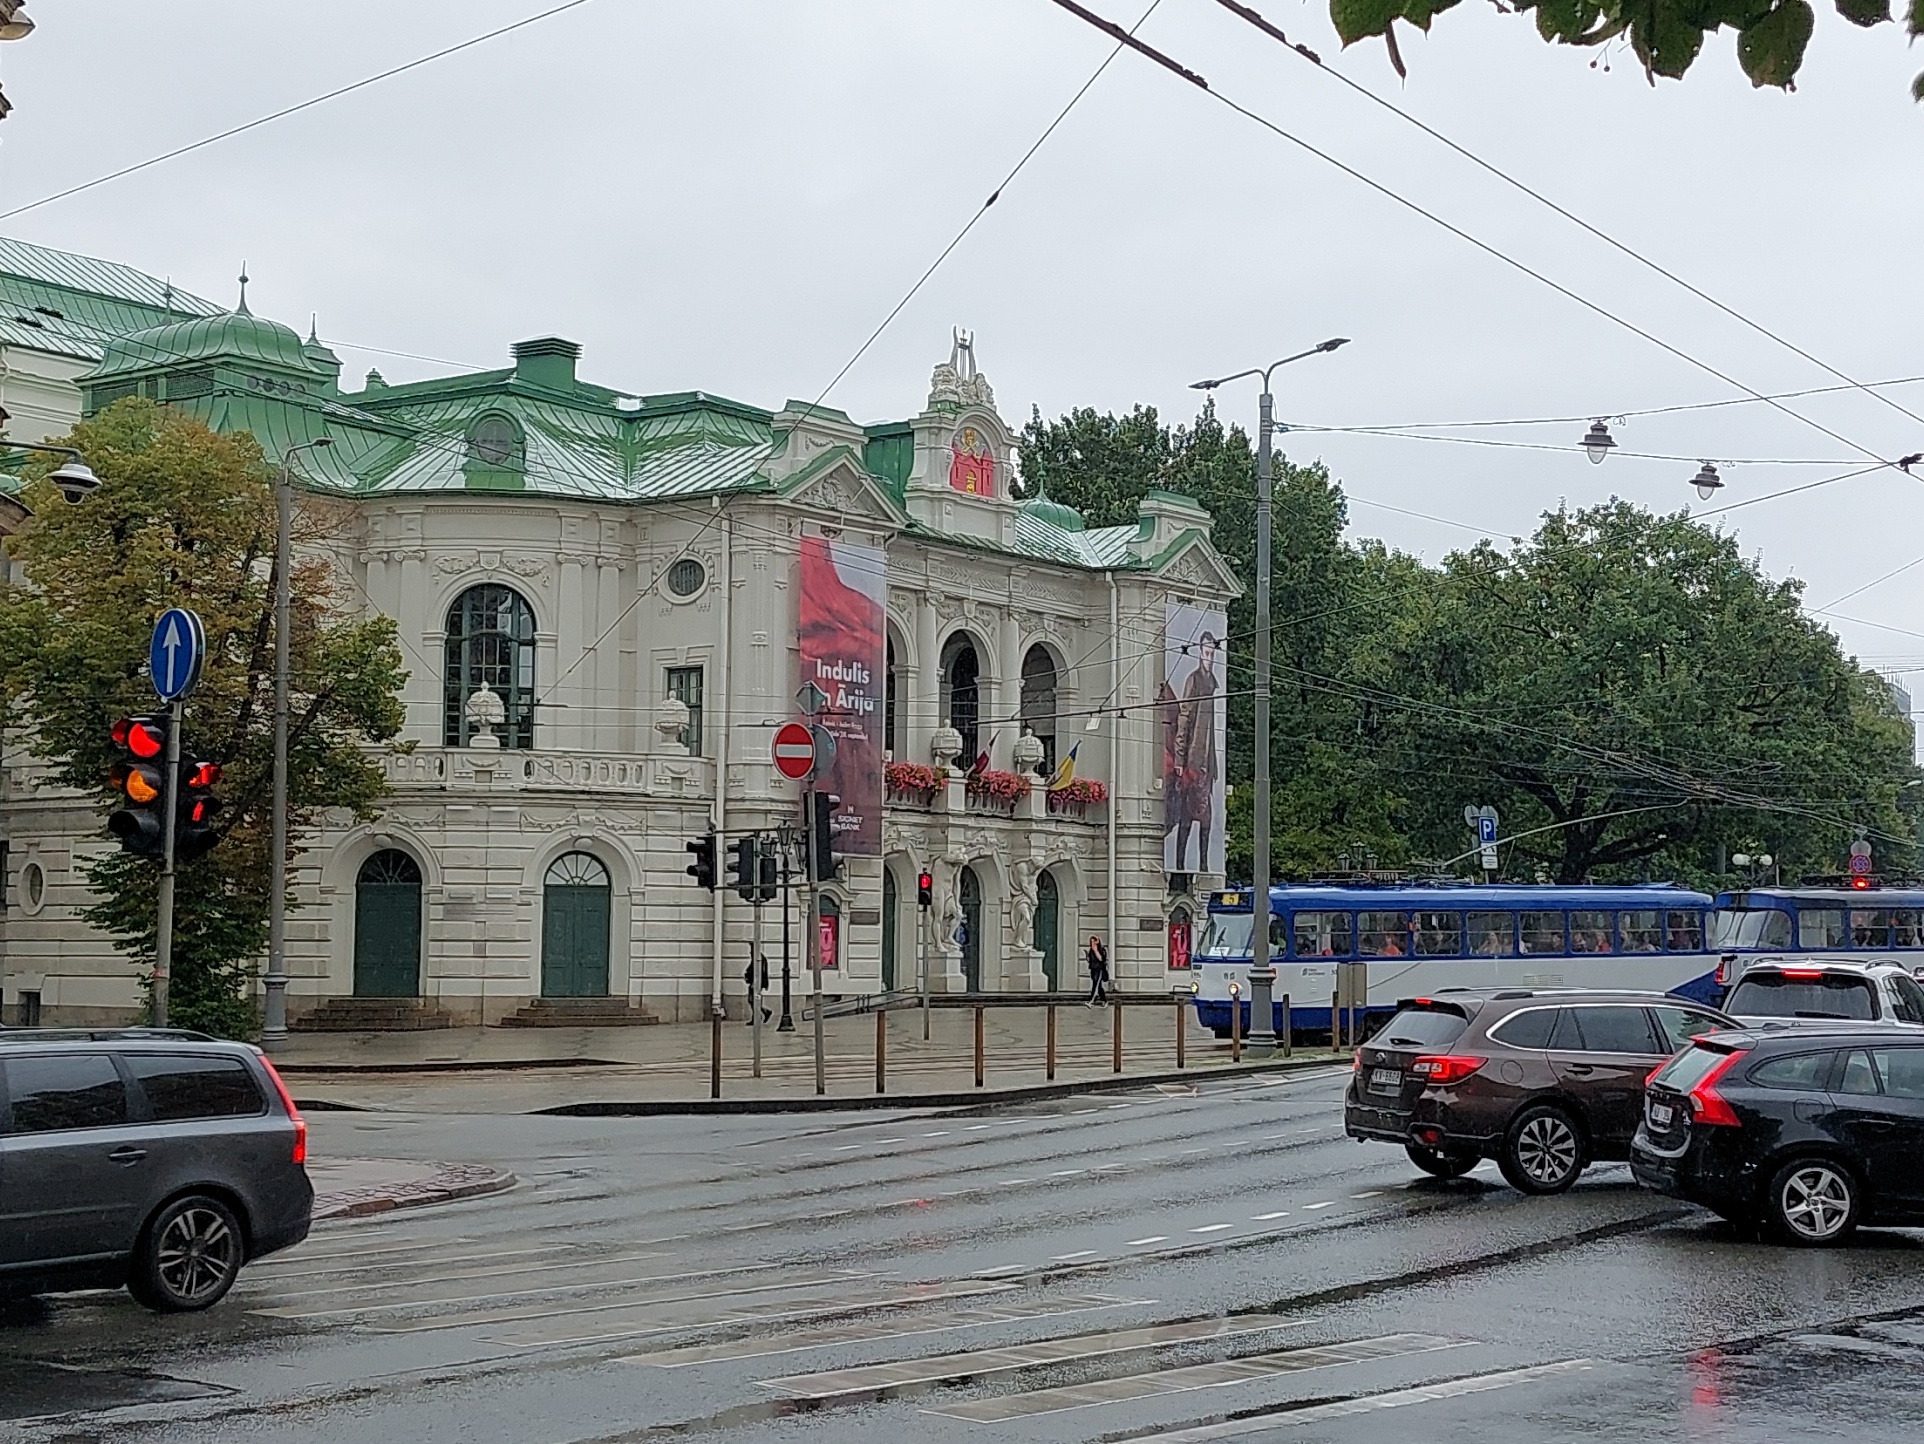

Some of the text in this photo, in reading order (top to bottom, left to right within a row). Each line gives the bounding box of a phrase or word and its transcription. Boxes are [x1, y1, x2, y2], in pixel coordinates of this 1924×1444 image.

[816, 658, 870, 684] Indulis
[835, 683, 874, 716] Ārija
[1482, 820, 1492, 840] P
